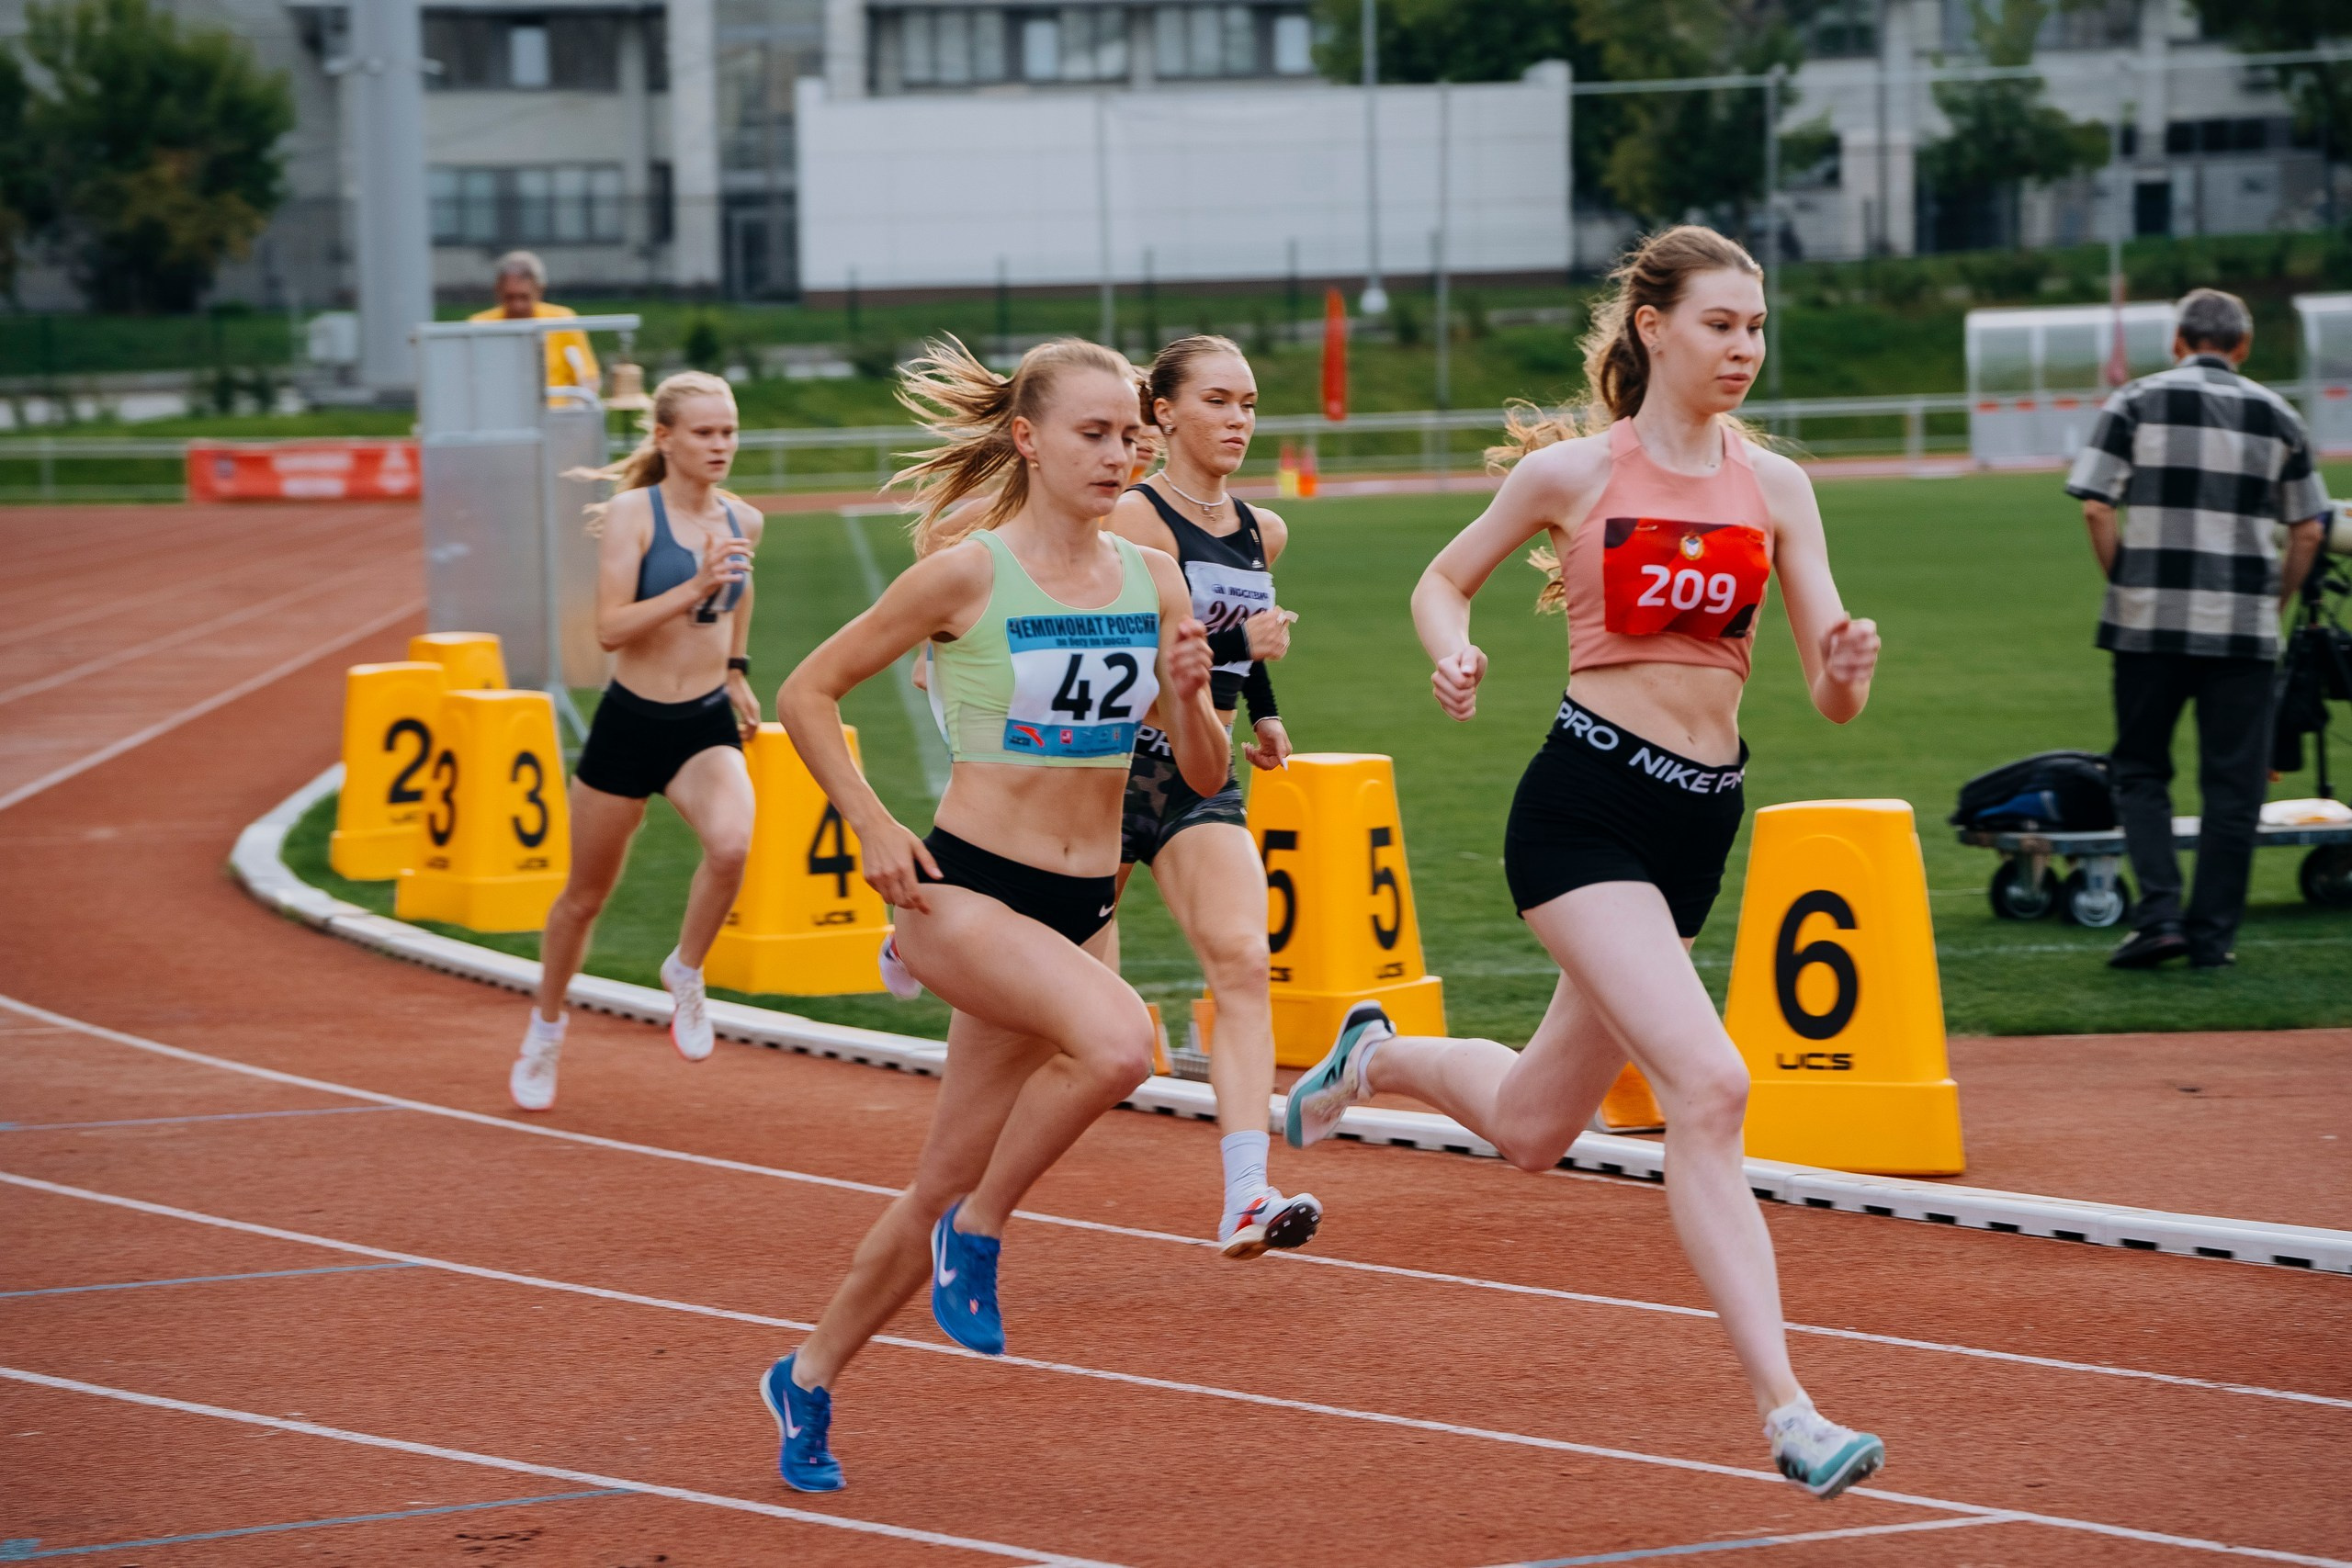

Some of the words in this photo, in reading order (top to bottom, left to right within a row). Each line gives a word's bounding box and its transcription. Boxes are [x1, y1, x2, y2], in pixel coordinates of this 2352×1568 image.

[1010, 617, 1102, 638] ЧЕМПИОНАТ
[1204, 600, 1267, 634] 20
[1637, 564, 1736, 614] 209
[1051, 652, 1138, 721] 42
[383, 717, 433, 804] 2
[1556, 701, 1620, 751] PRO
[1628, 747, 1717, 795] NIKE
[428, 750, 458, 847] 3
[510, 750, 549, 848] 3
[807, 801, 856, 898] 4
[1262, 829, 1297, 953] 5
[1370, 827, 1401, 950] 5
[812, 910, 856, 926] UCS
[1270, 966, 1292, 983] CS
[1774, 888, 1860, 1041] 6
[1775, 1052, 1854, 1071] UCS
